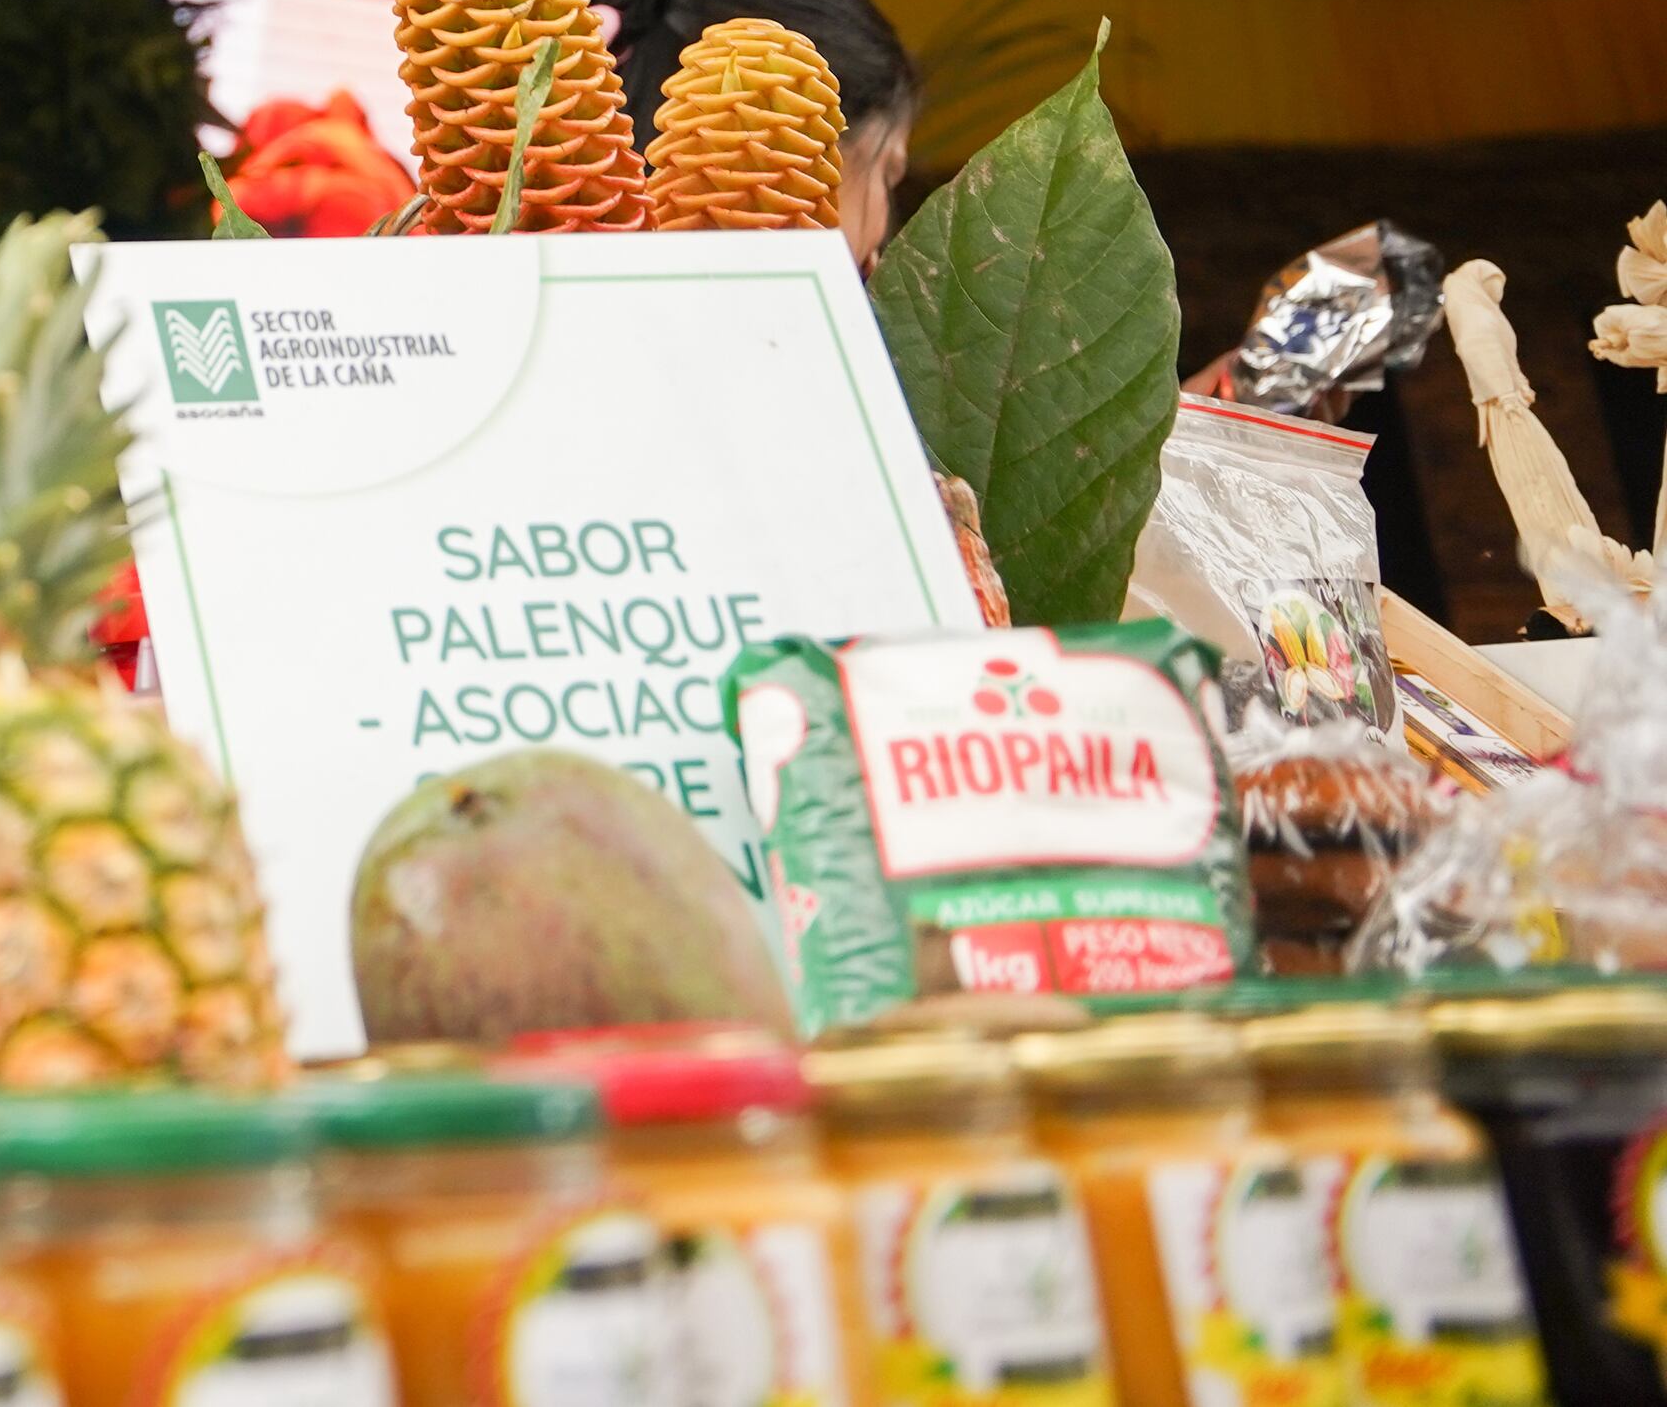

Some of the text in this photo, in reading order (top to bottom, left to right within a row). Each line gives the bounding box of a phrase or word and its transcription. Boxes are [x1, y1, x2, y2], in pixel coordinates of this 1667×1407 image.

[251, 310, 336, 333] SECTOR
[260, 334, 456, 361] AGROINDUSTRIAL
[265, 357, 396, 388] DE LA CAÑA
[175, 404, 265, 420] asocaña
[436, 520, 688, 582] SABOR
[888, 732, 1169, 804] RIOPAILA
[1062, 924, 1145, 954] PESO
